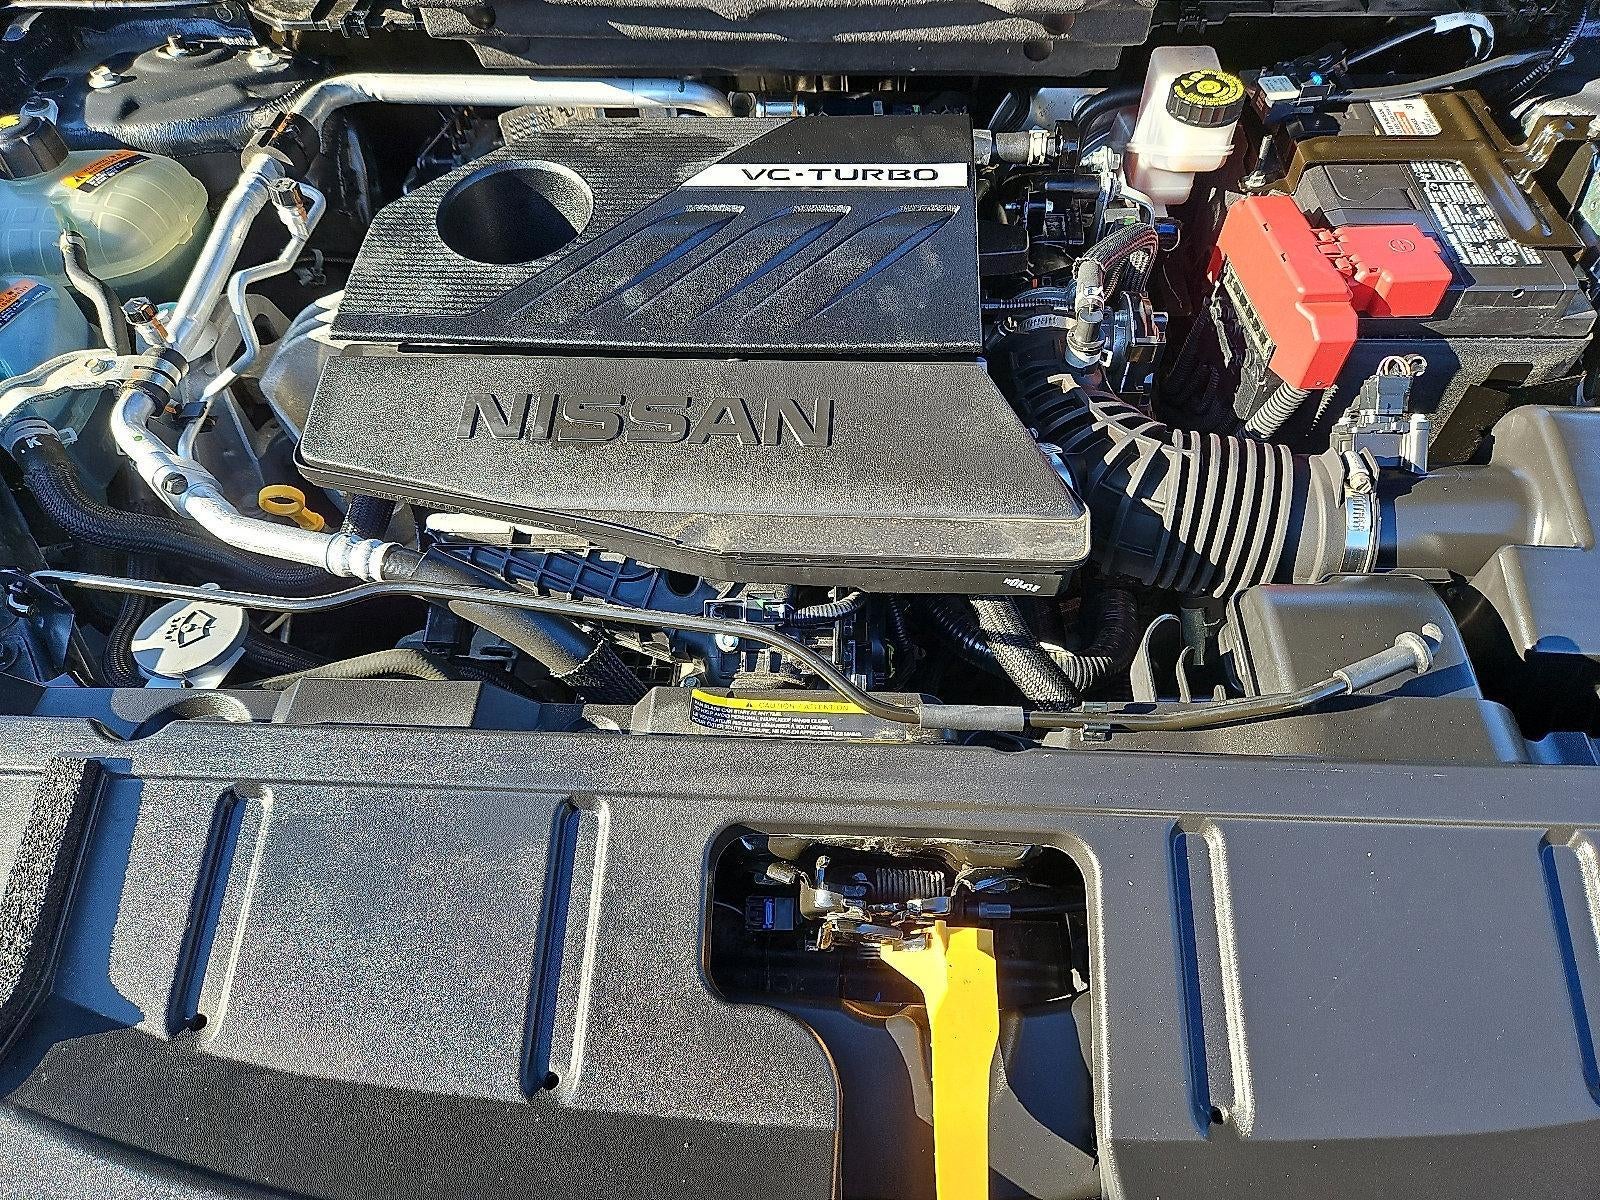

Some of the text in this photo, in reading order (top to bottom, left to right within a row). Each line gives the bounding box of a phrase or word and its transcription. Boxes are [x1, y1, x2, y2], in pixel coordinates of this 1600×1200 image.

[741, 168, 939, 181] VC-TURBO
[455, 392, 834, 448] NISSAN
[759, 702, 795, 710] CAUTION
[804, 703, 849, 711] ATTENTION
